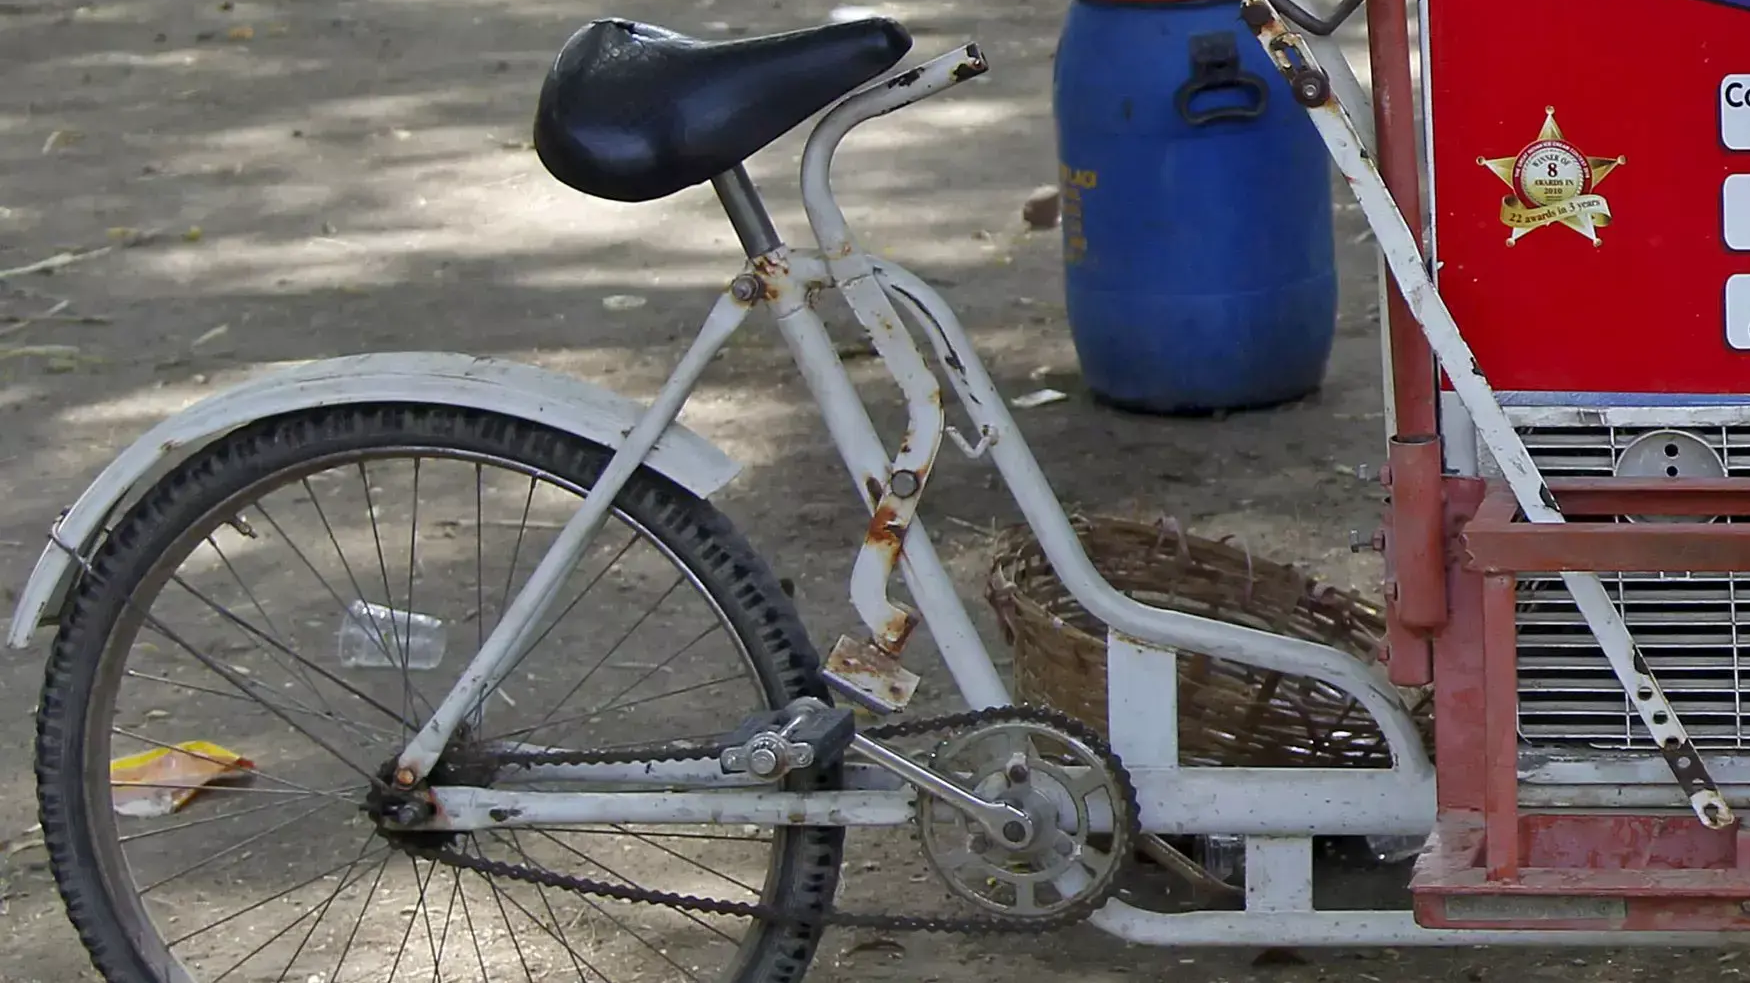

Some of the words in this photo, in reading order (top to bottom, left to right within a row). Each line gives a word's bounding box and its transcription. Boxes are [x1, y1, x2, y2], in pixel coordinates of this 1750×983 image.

[1532, 154, 1559, 167] WINNER
[1548, 162, 1558, 177] 8
[1509, 213, 1522, 223] 22
[1524, 209, 1556, 223] awards
[1558, 206, 1568, 215] in
[1568, 201, 1576, 211] 3
[1578, 199, 1601, 212] years
